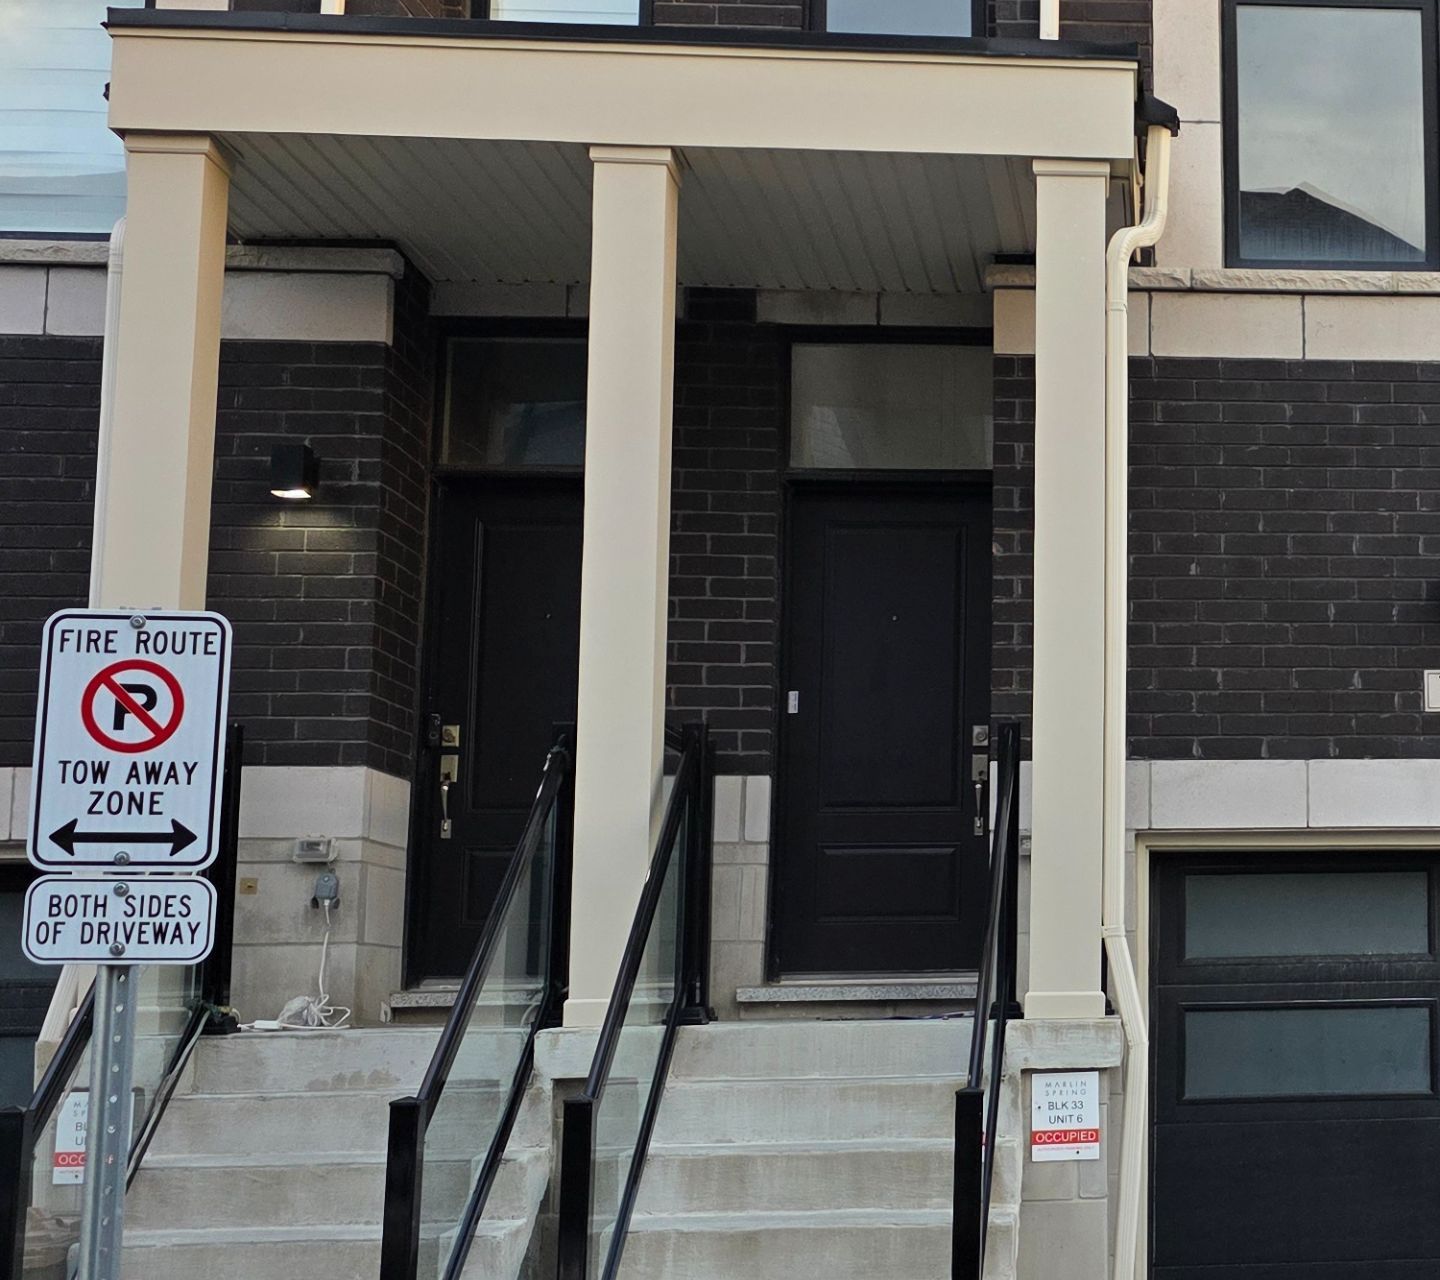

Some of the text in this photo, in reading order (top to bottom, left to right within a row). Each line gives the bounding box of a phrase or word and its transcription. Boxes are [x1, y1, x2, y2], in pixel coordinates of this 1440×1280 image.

[59, 629, 218, 655] FIRE ROUTE
[58, 760, 199, 786] TOW AWAY
[87, 790, 164, 816] ZONE
[48, 893, 192, 919] BOTH SIDES
[35, 921, 201, 946] OF DRIVEWAY
[1048, 1101, 1084, 1110] BLK 33
[1048, 1114, 1083, 1124] UNIT 6
[1035, 1131, 1096, 1142] OCCUPIED
